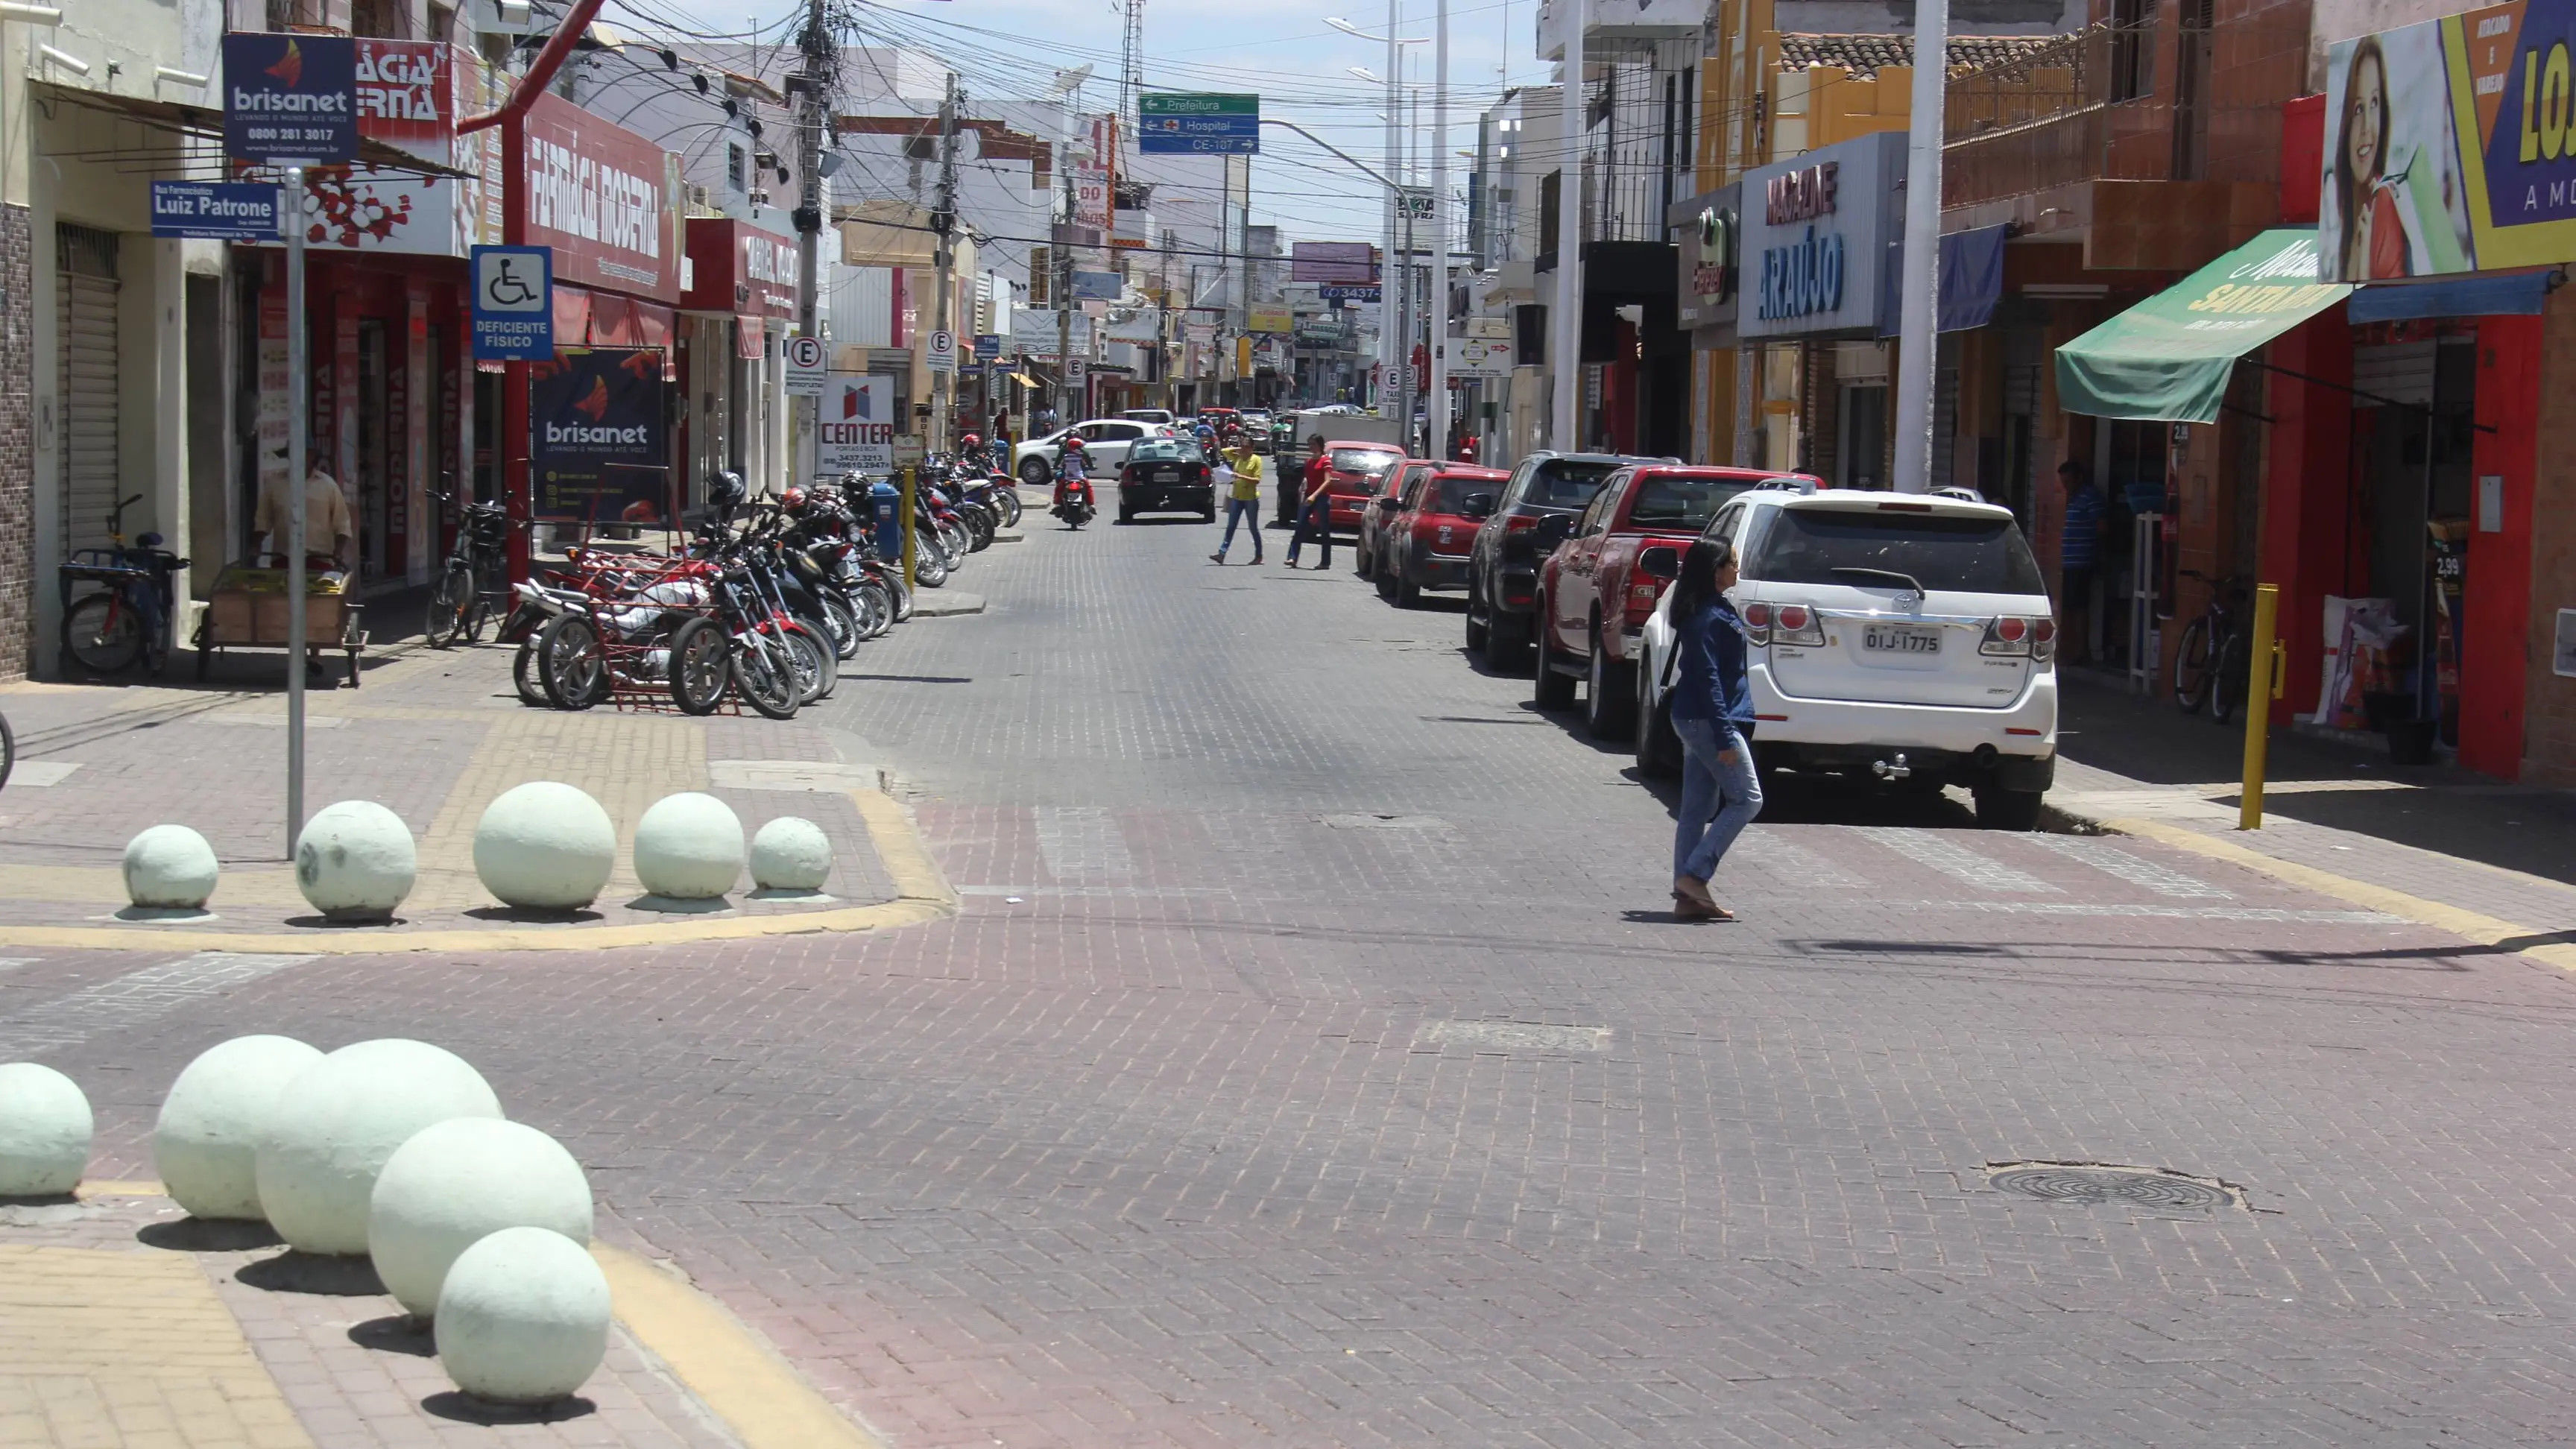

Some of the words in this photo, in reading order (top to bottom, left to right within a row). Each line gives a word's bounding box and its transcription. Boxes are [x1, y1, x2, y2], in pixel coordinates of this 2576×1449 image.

[234, 86, 347, 112] brisanet
[1167, 101, 1219, 110] Prefeitura
[1187, 121, 1230, 132] Hospital
[248, 128, 277, 139] 0800
[280, 129, 300, 140] 281
[305, 129, 334, 140] 3017
[1766, 160, 1839, 226] MAGAZINE
[156, 195, 194, 215] Luiz
[199, 196, 271, 217] Patrone
[1758, 225, 1844, 320] ARAÚJO
[1342, 288, 1380, 298] 3437-
[477, 321, 547, 334] DEFICIENTE
[484, 333, 532, 347] FÍSICO
[938, 335, 945, 349] E
[801, 343, 812, 362] E
[1071, 361, 1079, 373] E
[1389, 373, 1397, 385] E
[546, 421, 647, 443] brisanet
[821, 423, 892, 444] CENTER
[2437, 558, 2459, 578] 2,99
